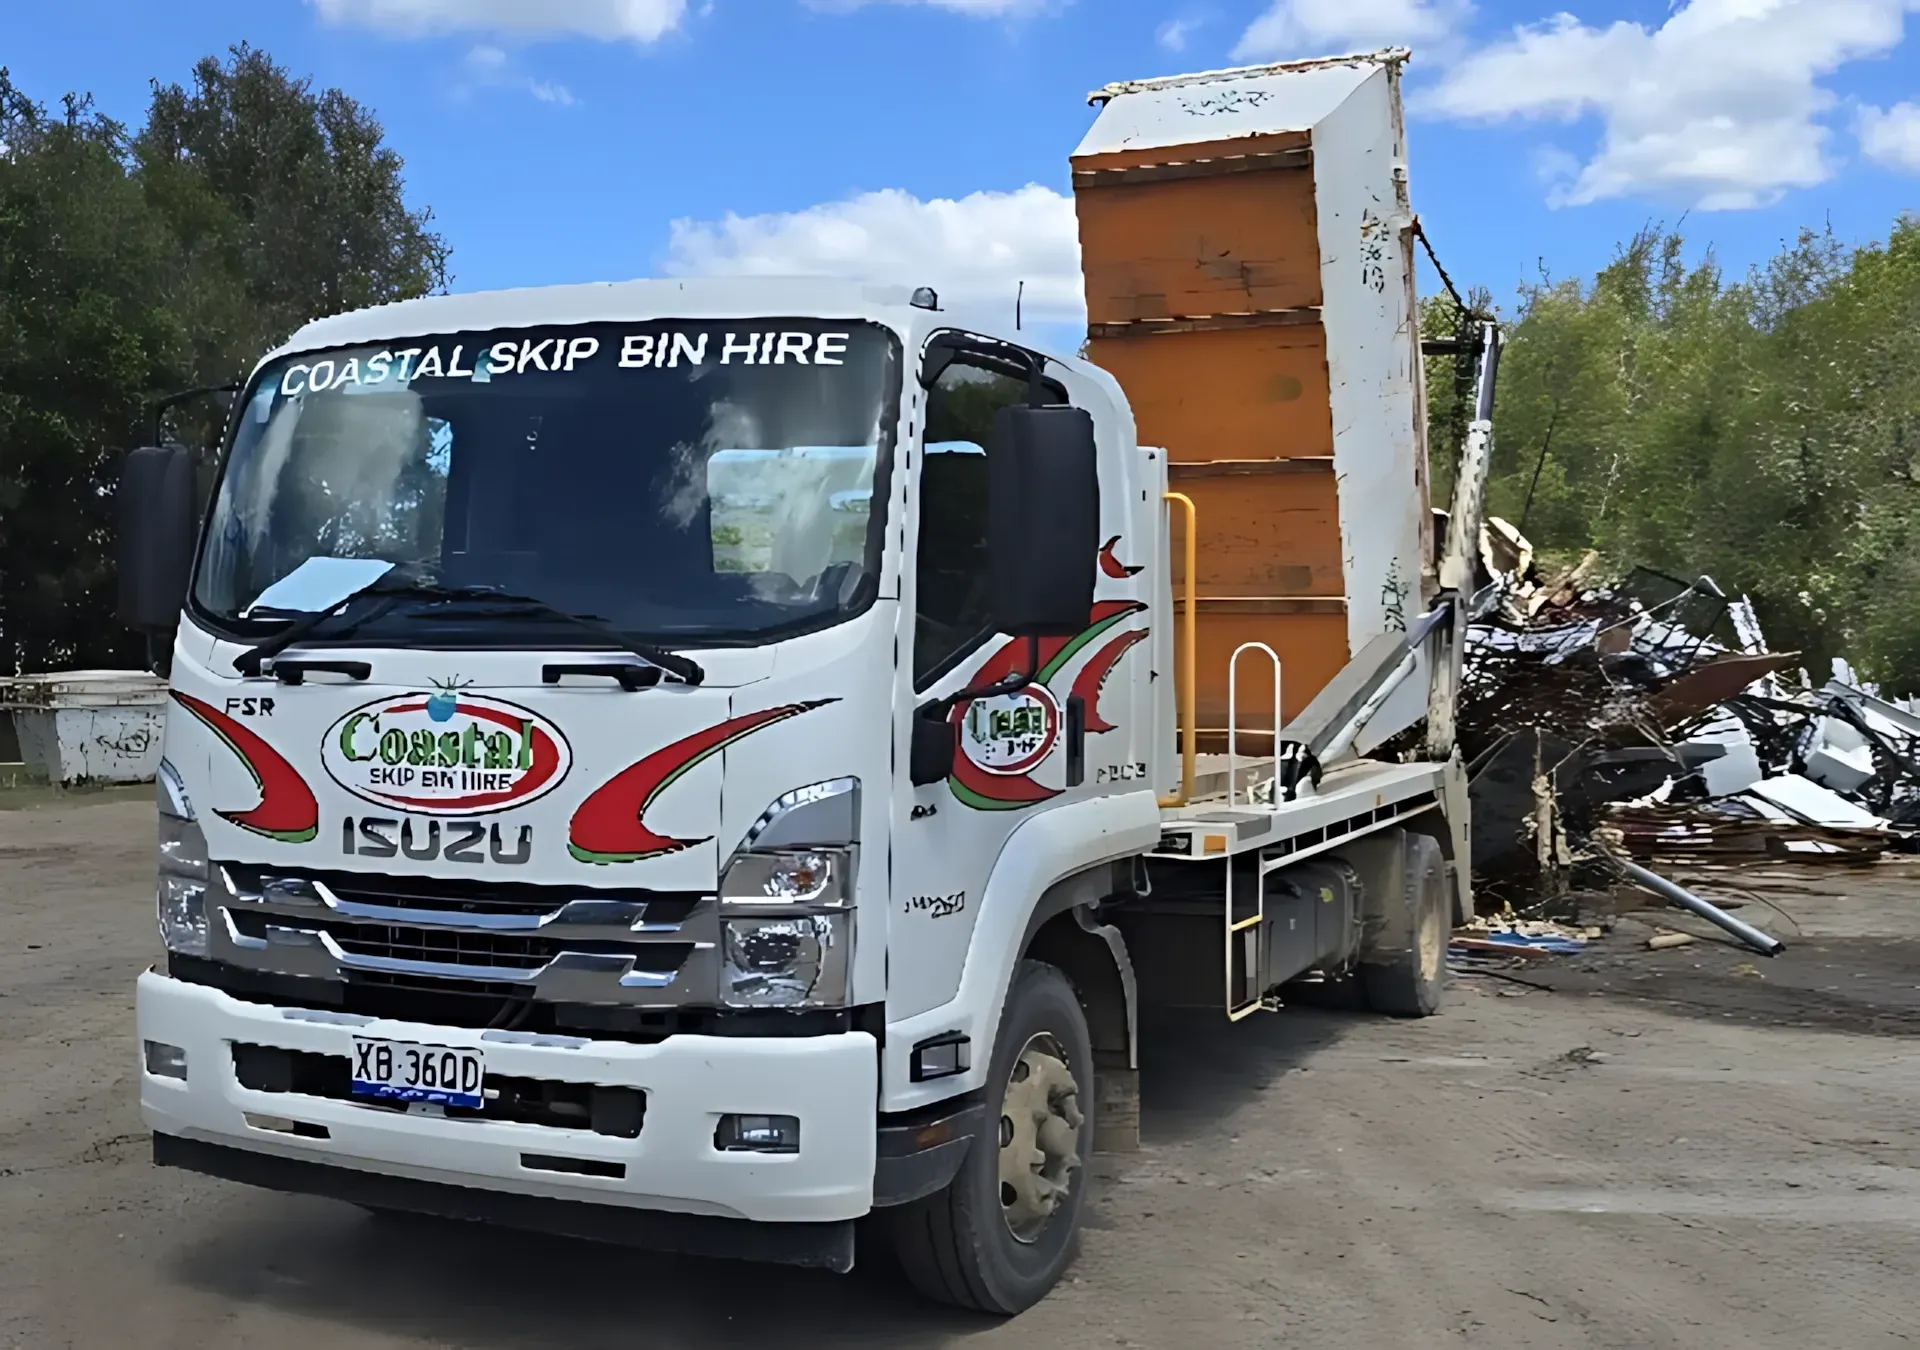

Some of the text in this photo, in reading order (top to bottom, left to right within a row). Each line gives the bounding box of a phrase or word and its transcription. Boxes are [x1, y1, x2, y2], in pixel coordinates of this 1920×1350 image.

[280, 331, 850, 398] COASTAL SKIP BIN HIRE
[225, 697, 276, 717] FSR
[339, 712, 535, 770] Coastal
[370, 767, 415, 787] SKIP
[342, 816, 533, 864] ISUZU
